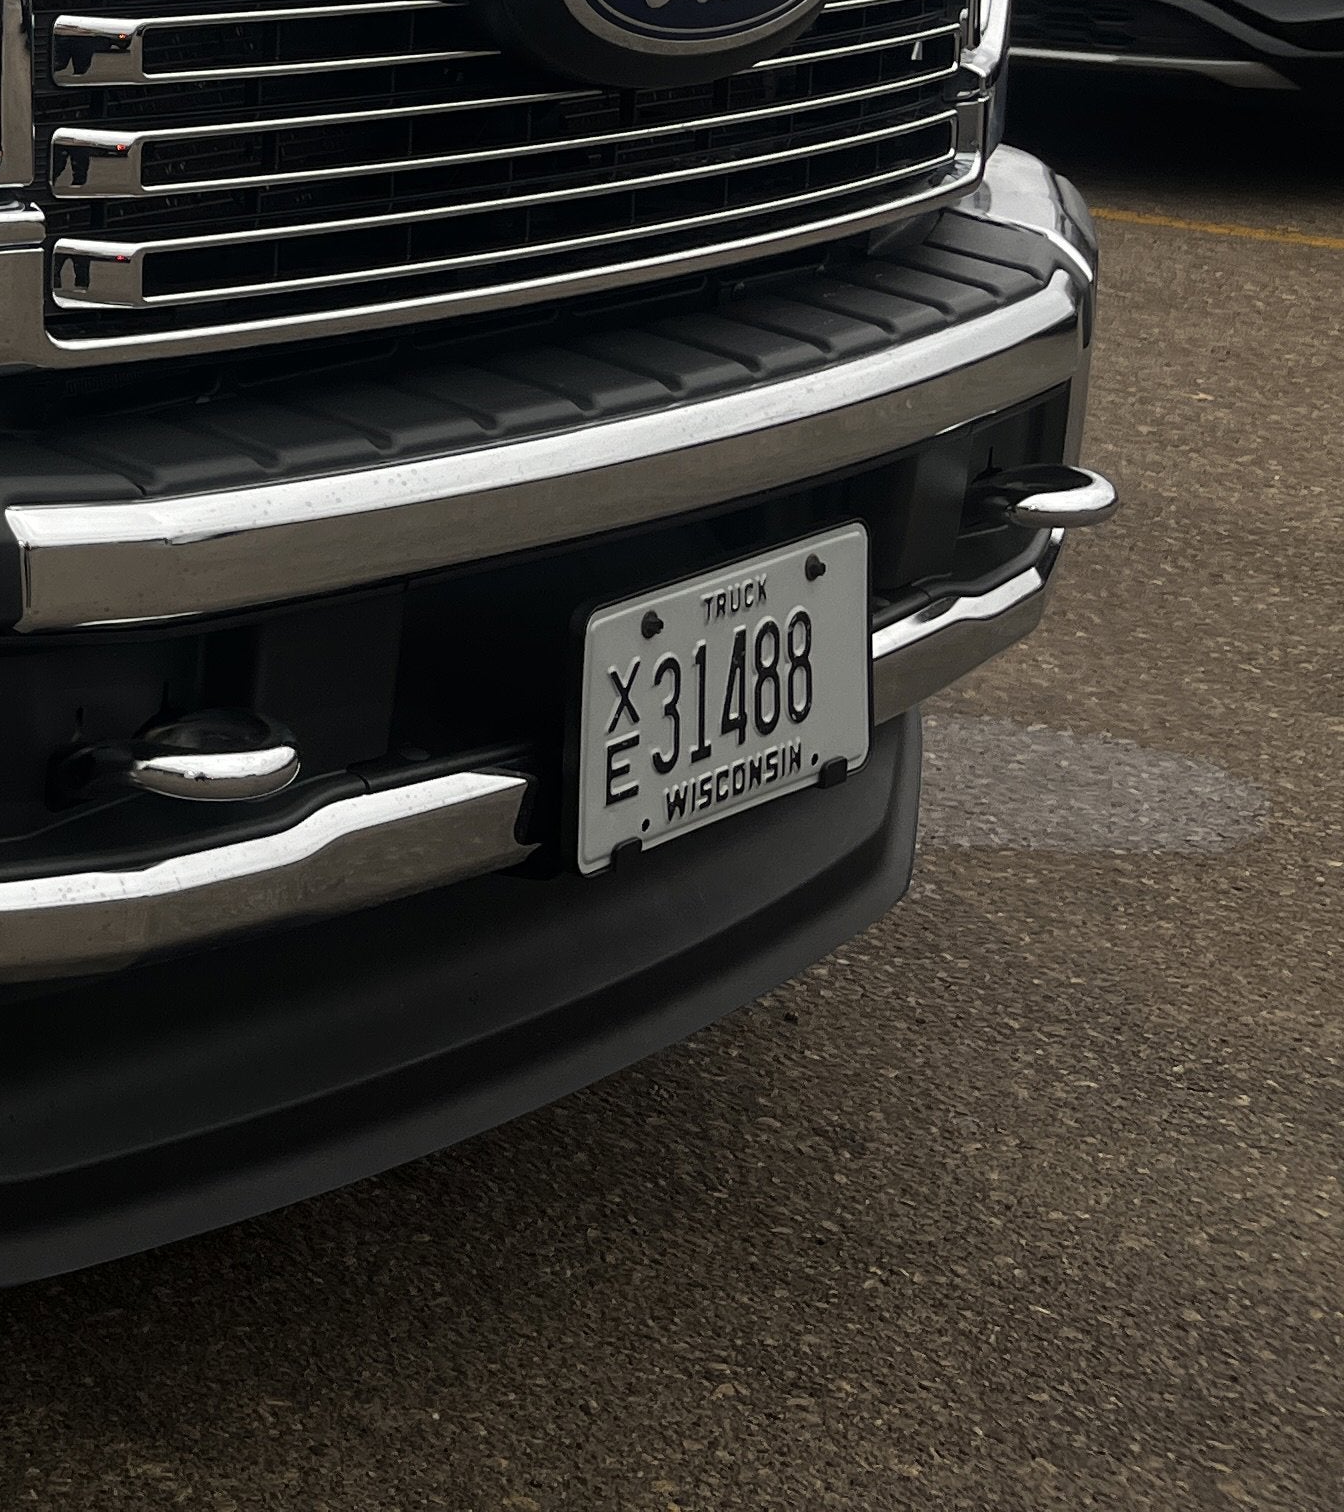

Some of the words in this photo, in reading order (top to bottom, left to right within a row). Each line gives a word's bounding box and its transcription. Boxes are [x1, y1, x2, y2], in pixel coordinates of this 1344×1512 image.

[701, 574, 768, 622] TRUCK
[650, 606, 814, 775] 31488
[665, 738, 802, 822] WISCONSIN
